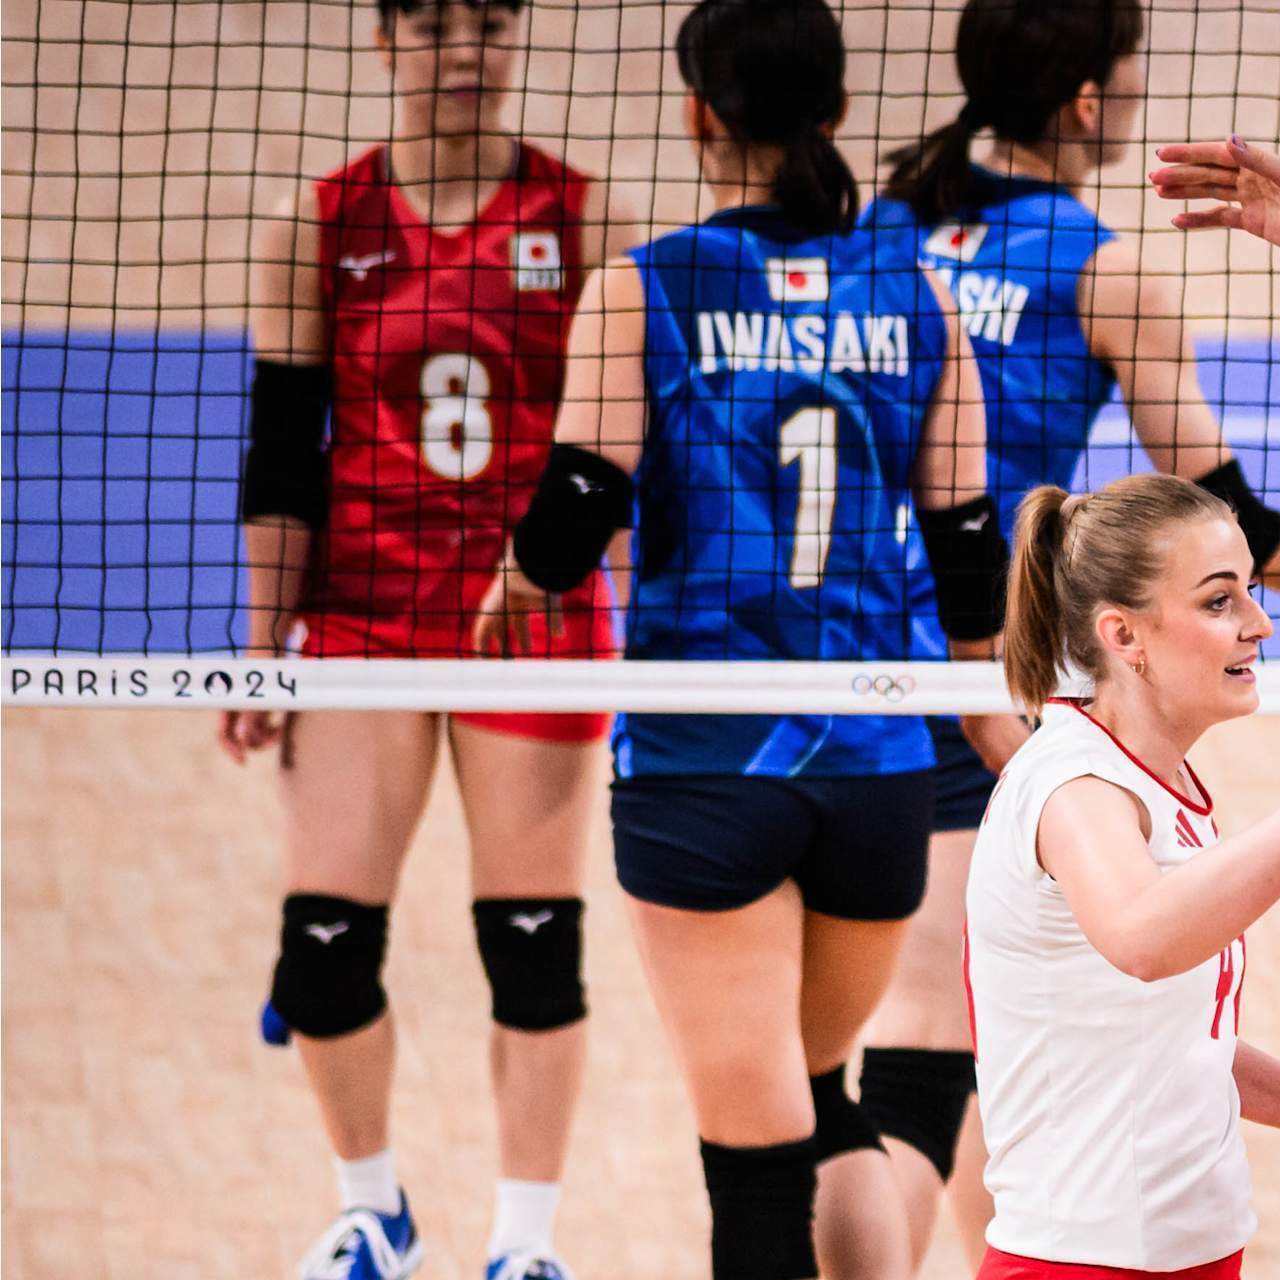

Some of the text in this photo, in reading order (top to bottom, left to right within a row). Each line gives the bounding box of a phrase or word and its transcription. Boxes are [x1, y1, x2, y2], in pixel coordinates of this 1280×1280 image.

[697, 311, 909, 377] IWASAKI
[421, 353, 493, 480] 8
[780, 406, 838, 589] 1
